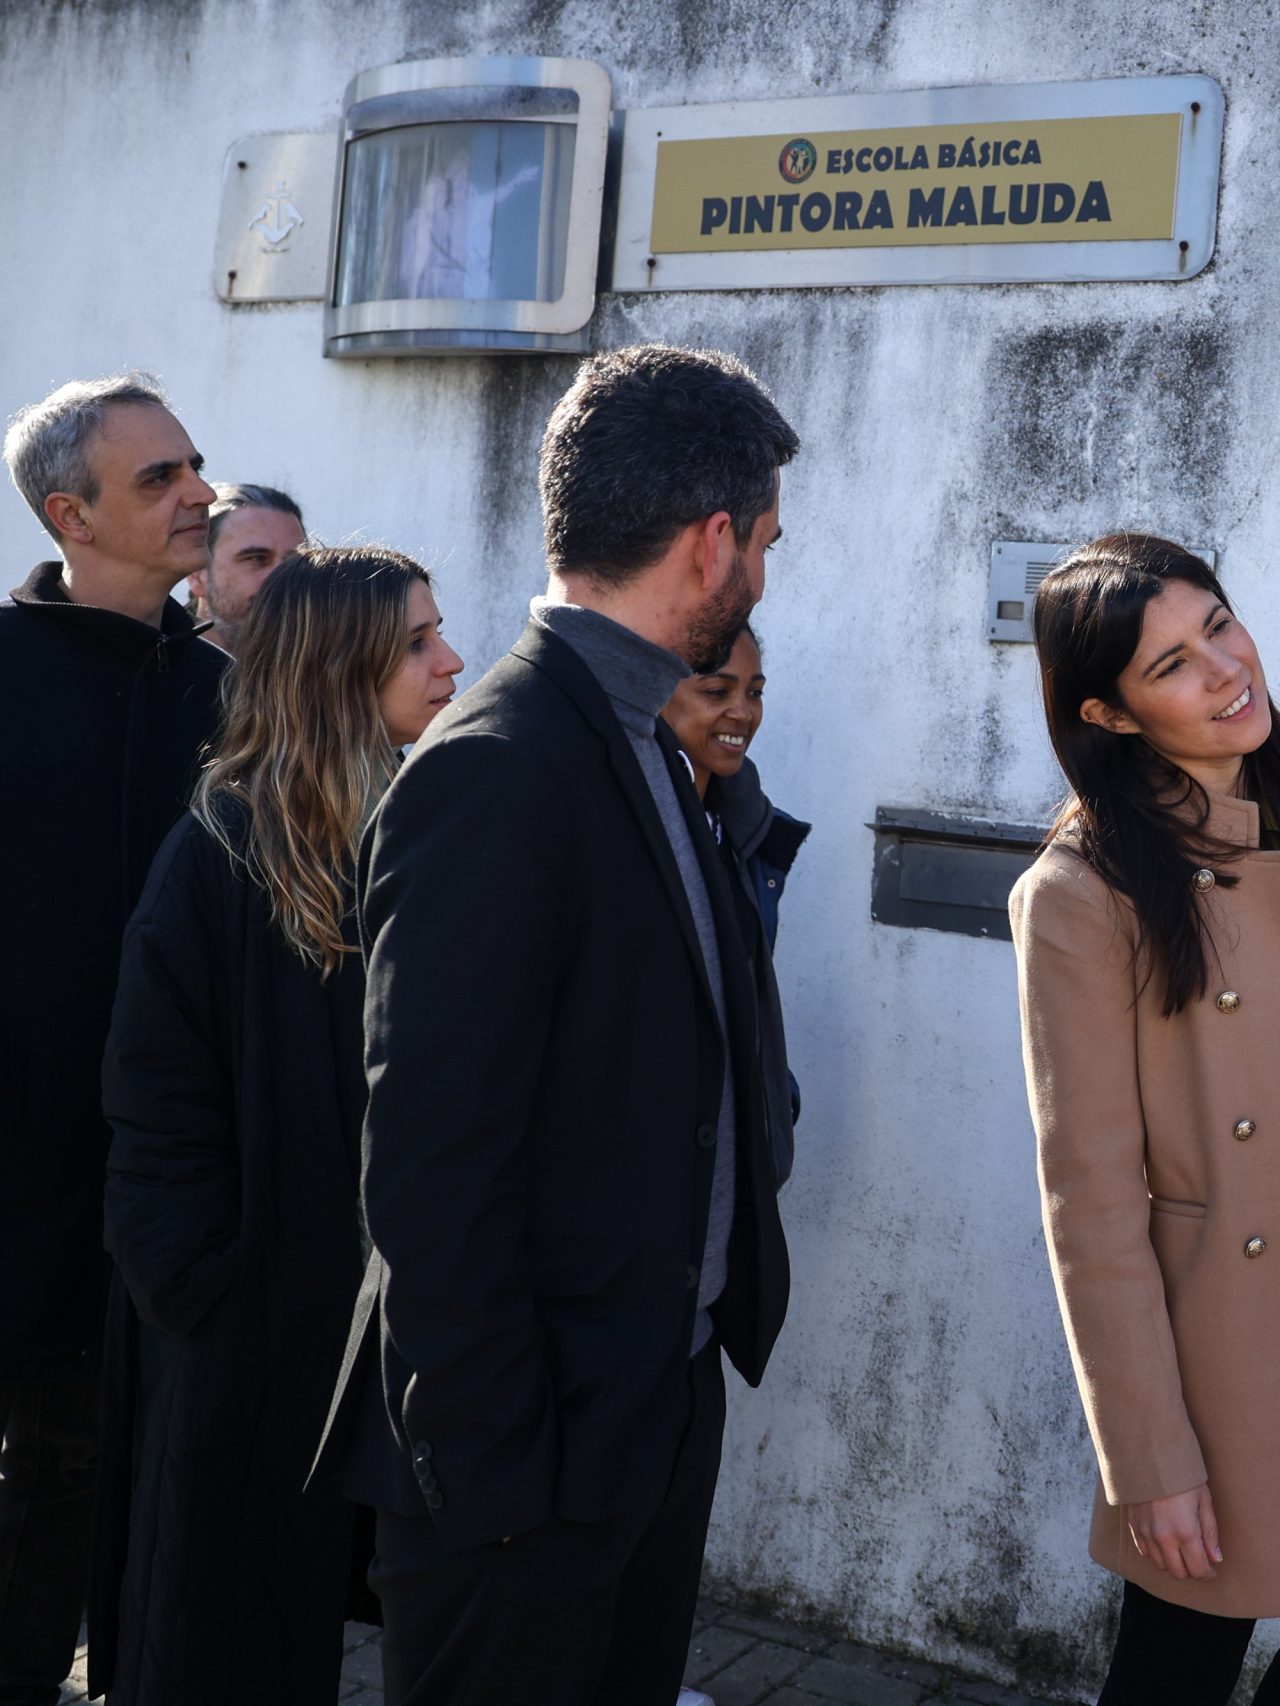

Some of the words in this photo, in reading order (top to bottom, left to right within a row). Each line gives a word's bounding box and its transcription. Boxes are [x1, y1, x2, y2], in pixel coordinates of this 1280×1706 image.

[826, 144, 930, 175] ESCOLA
[937, 136, 1042, 169] BÁSICA
[700, 189, 894, 236] PINTORA
[907, 180, 1112, 228] MALUDA
